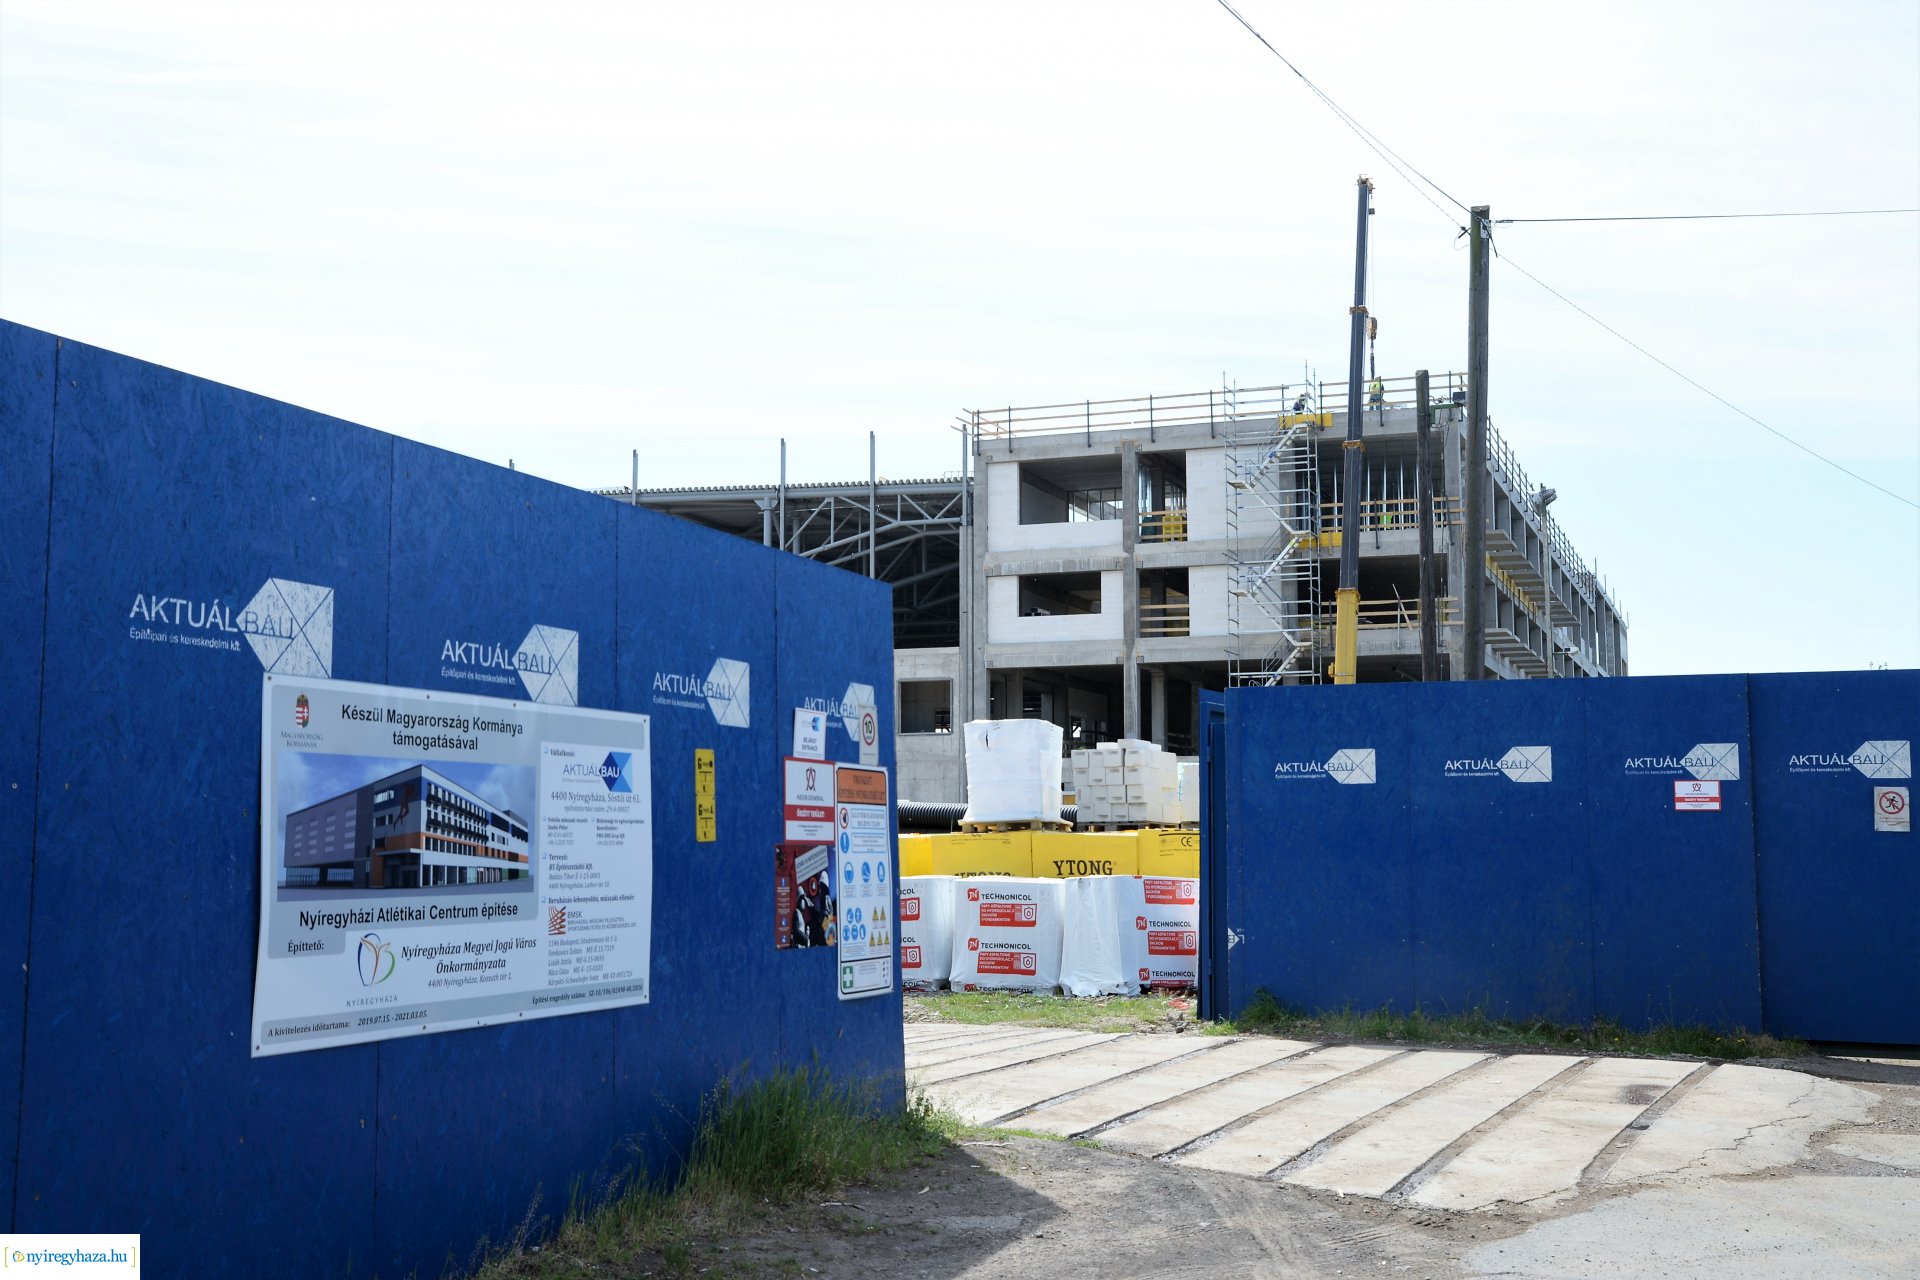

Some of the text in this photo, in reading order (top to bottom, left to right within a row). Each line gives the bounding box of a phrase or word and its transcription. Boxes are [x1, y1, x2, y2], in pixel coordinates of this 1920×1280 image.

[180, 634, 229, 649] kereskedelmi
[342, 704, 523, 737] Készül Magyarország Kormánya
[865, 720, 872, 734] 10
[392, 731, 478, 750] támogatásával
[550, 792, 567, 800] 4400
[980, 893, 1032, 901] TECHNONICOL
[300, 902, 518, 930] Nyíregyházi Atlétikai Centrum építése
[288, 941, 324, 954] Építtető:
[400, 937, 536, 960] Nyíregyháza Megyei Jogú Város
[436, 958, 506, 976] Önkormányzata
[428, 978, 442, 988] 4400
[346, 995, 398, 1008] NYÍREGYHÁZA
[268, 1021, 351, 1037] A kivitelezés időtartama:
